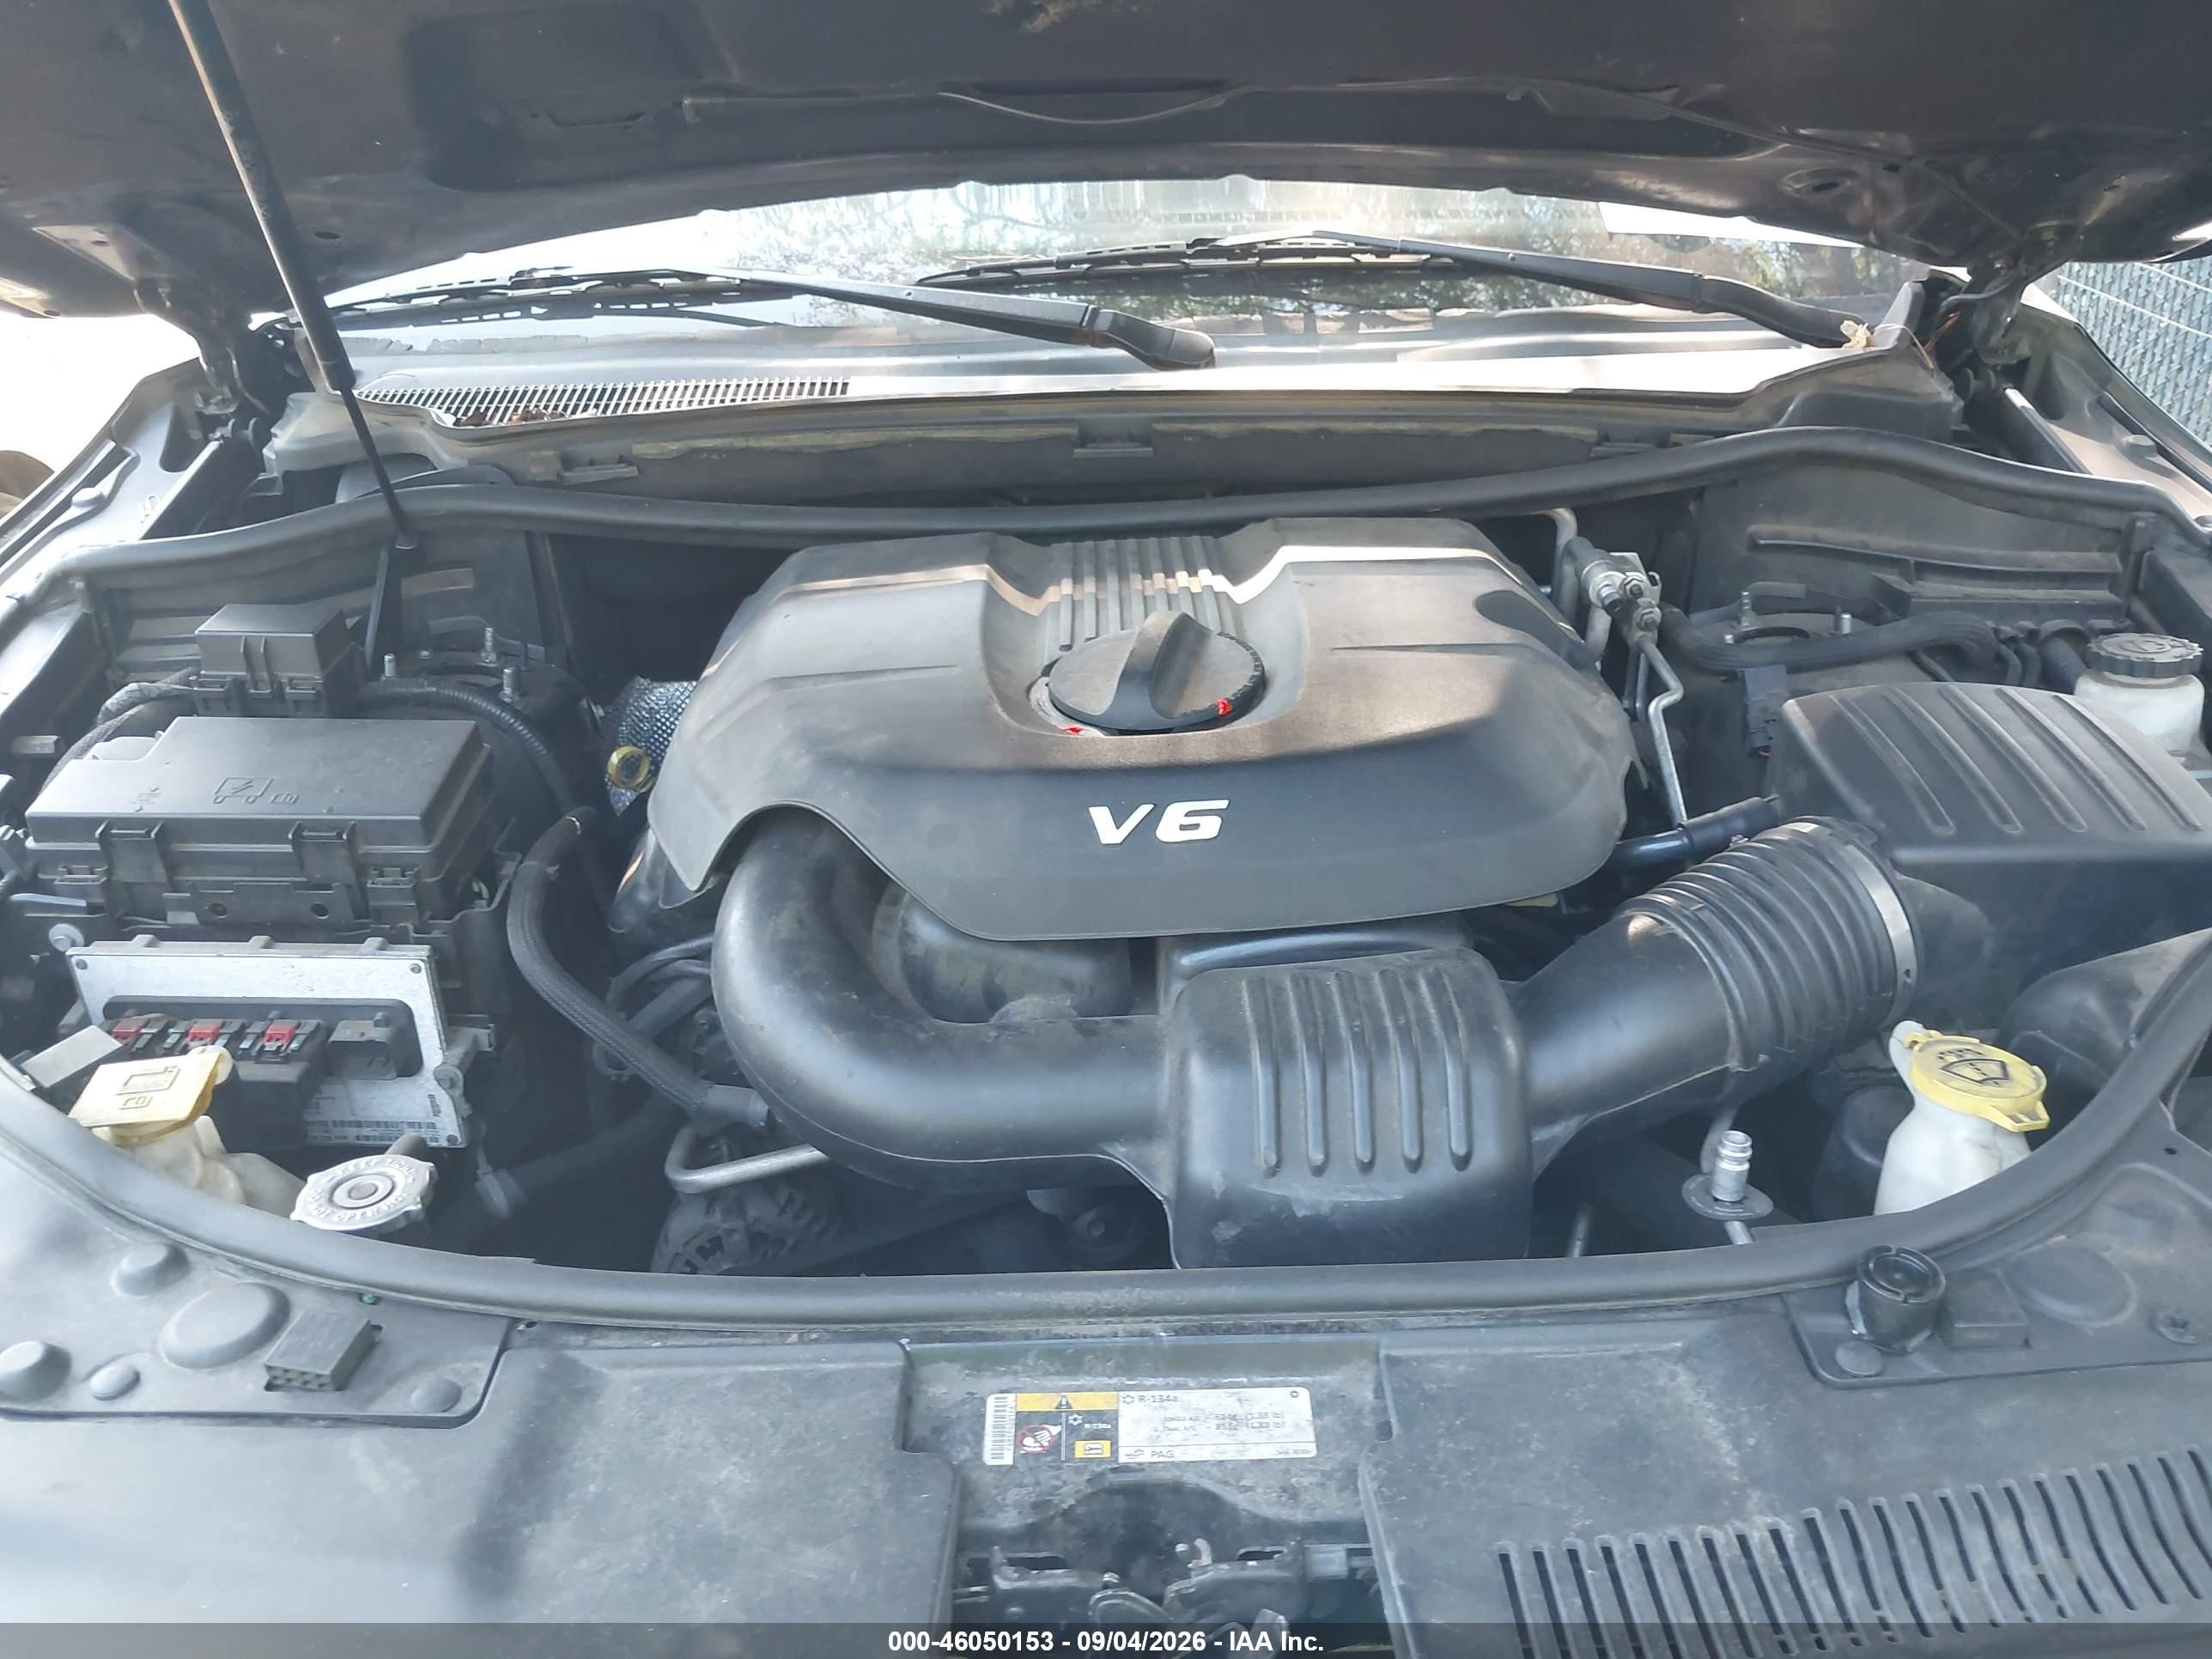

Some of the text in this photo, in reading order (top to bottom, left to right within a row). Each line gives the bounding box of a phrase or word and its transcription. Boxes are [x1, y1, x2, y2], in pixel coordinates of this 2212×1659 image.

[1088, 799, 1230, 845] V6
[1138, 1395, 1179, 1403] R-134a
[1151, 1449, 1175, 1458] PAG
